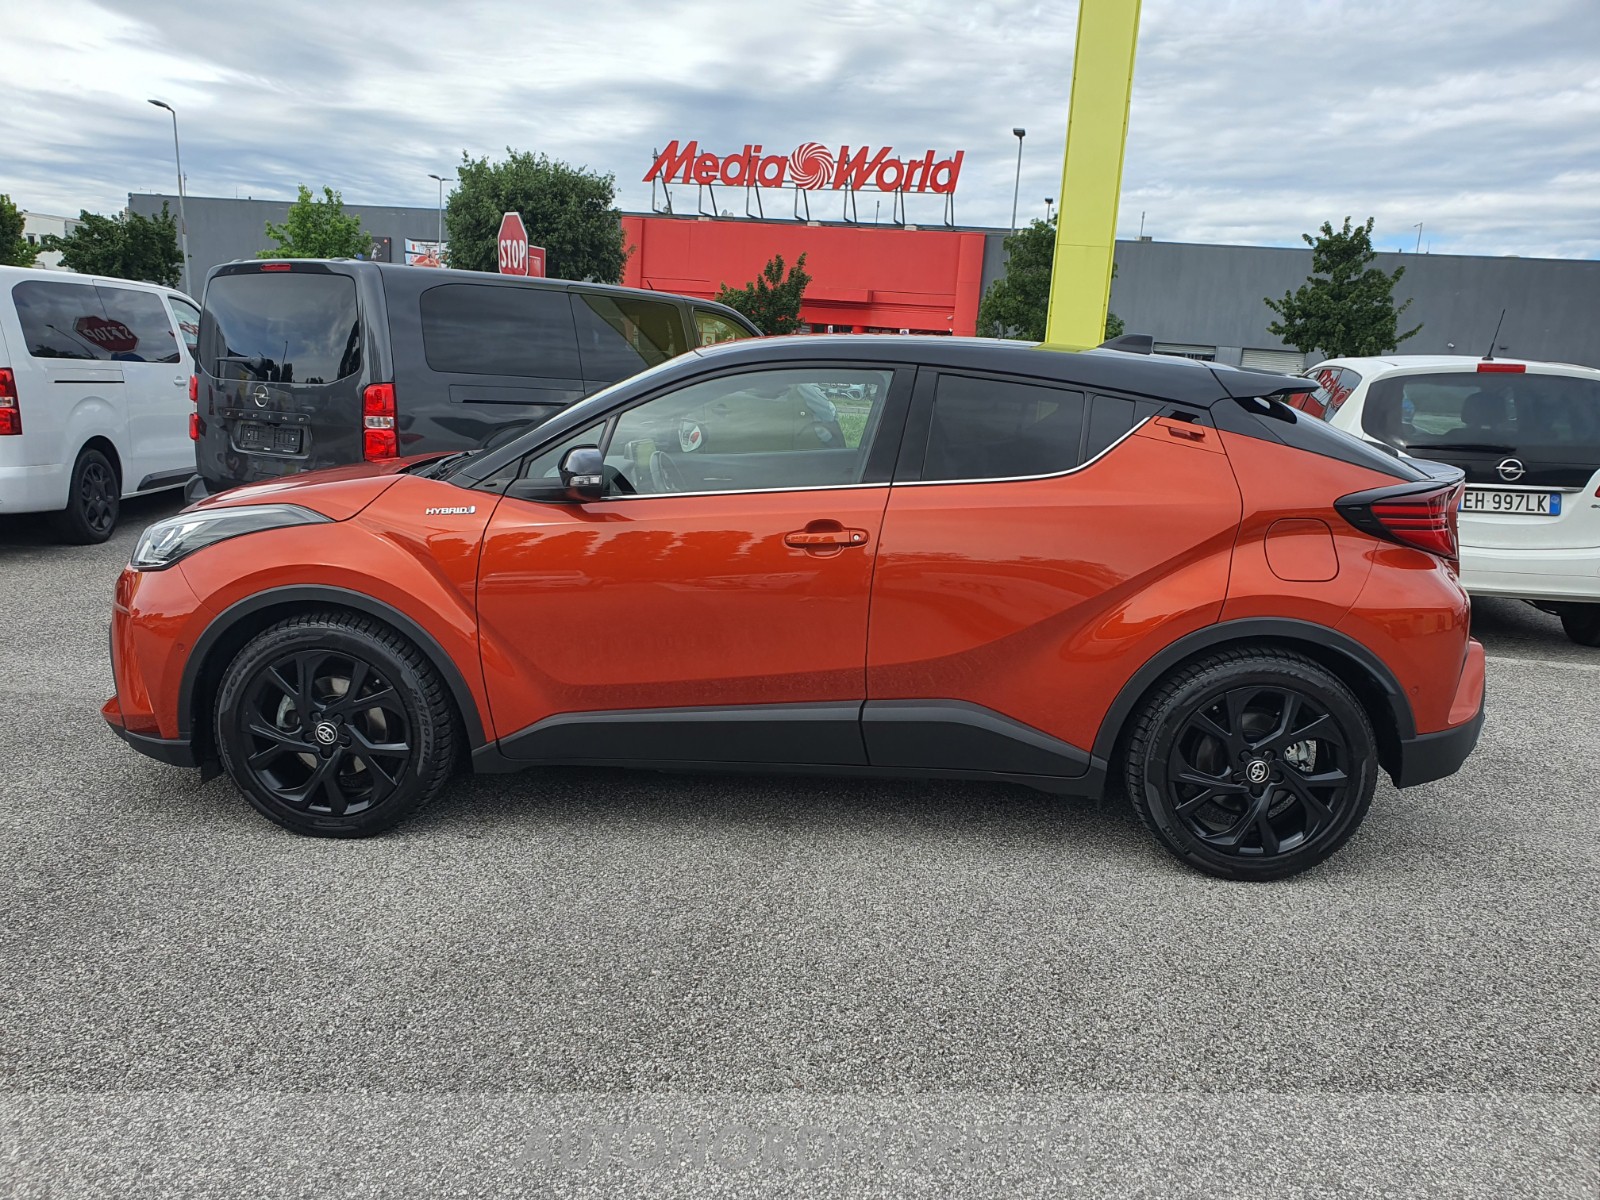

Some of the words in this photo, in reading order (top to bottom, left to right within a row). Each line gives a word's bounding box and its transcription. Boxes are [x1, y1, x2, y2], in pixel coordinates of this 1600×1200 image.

[642, 140, 788, 187] Media
[832, 145, 965, 193] World
[500, 239, 526, 269] STOP
[425, 506, 468, 515] HYBRID
[1463, 492, 1485, 510] EH
[1492, 493, 1547, 512] 997LK
